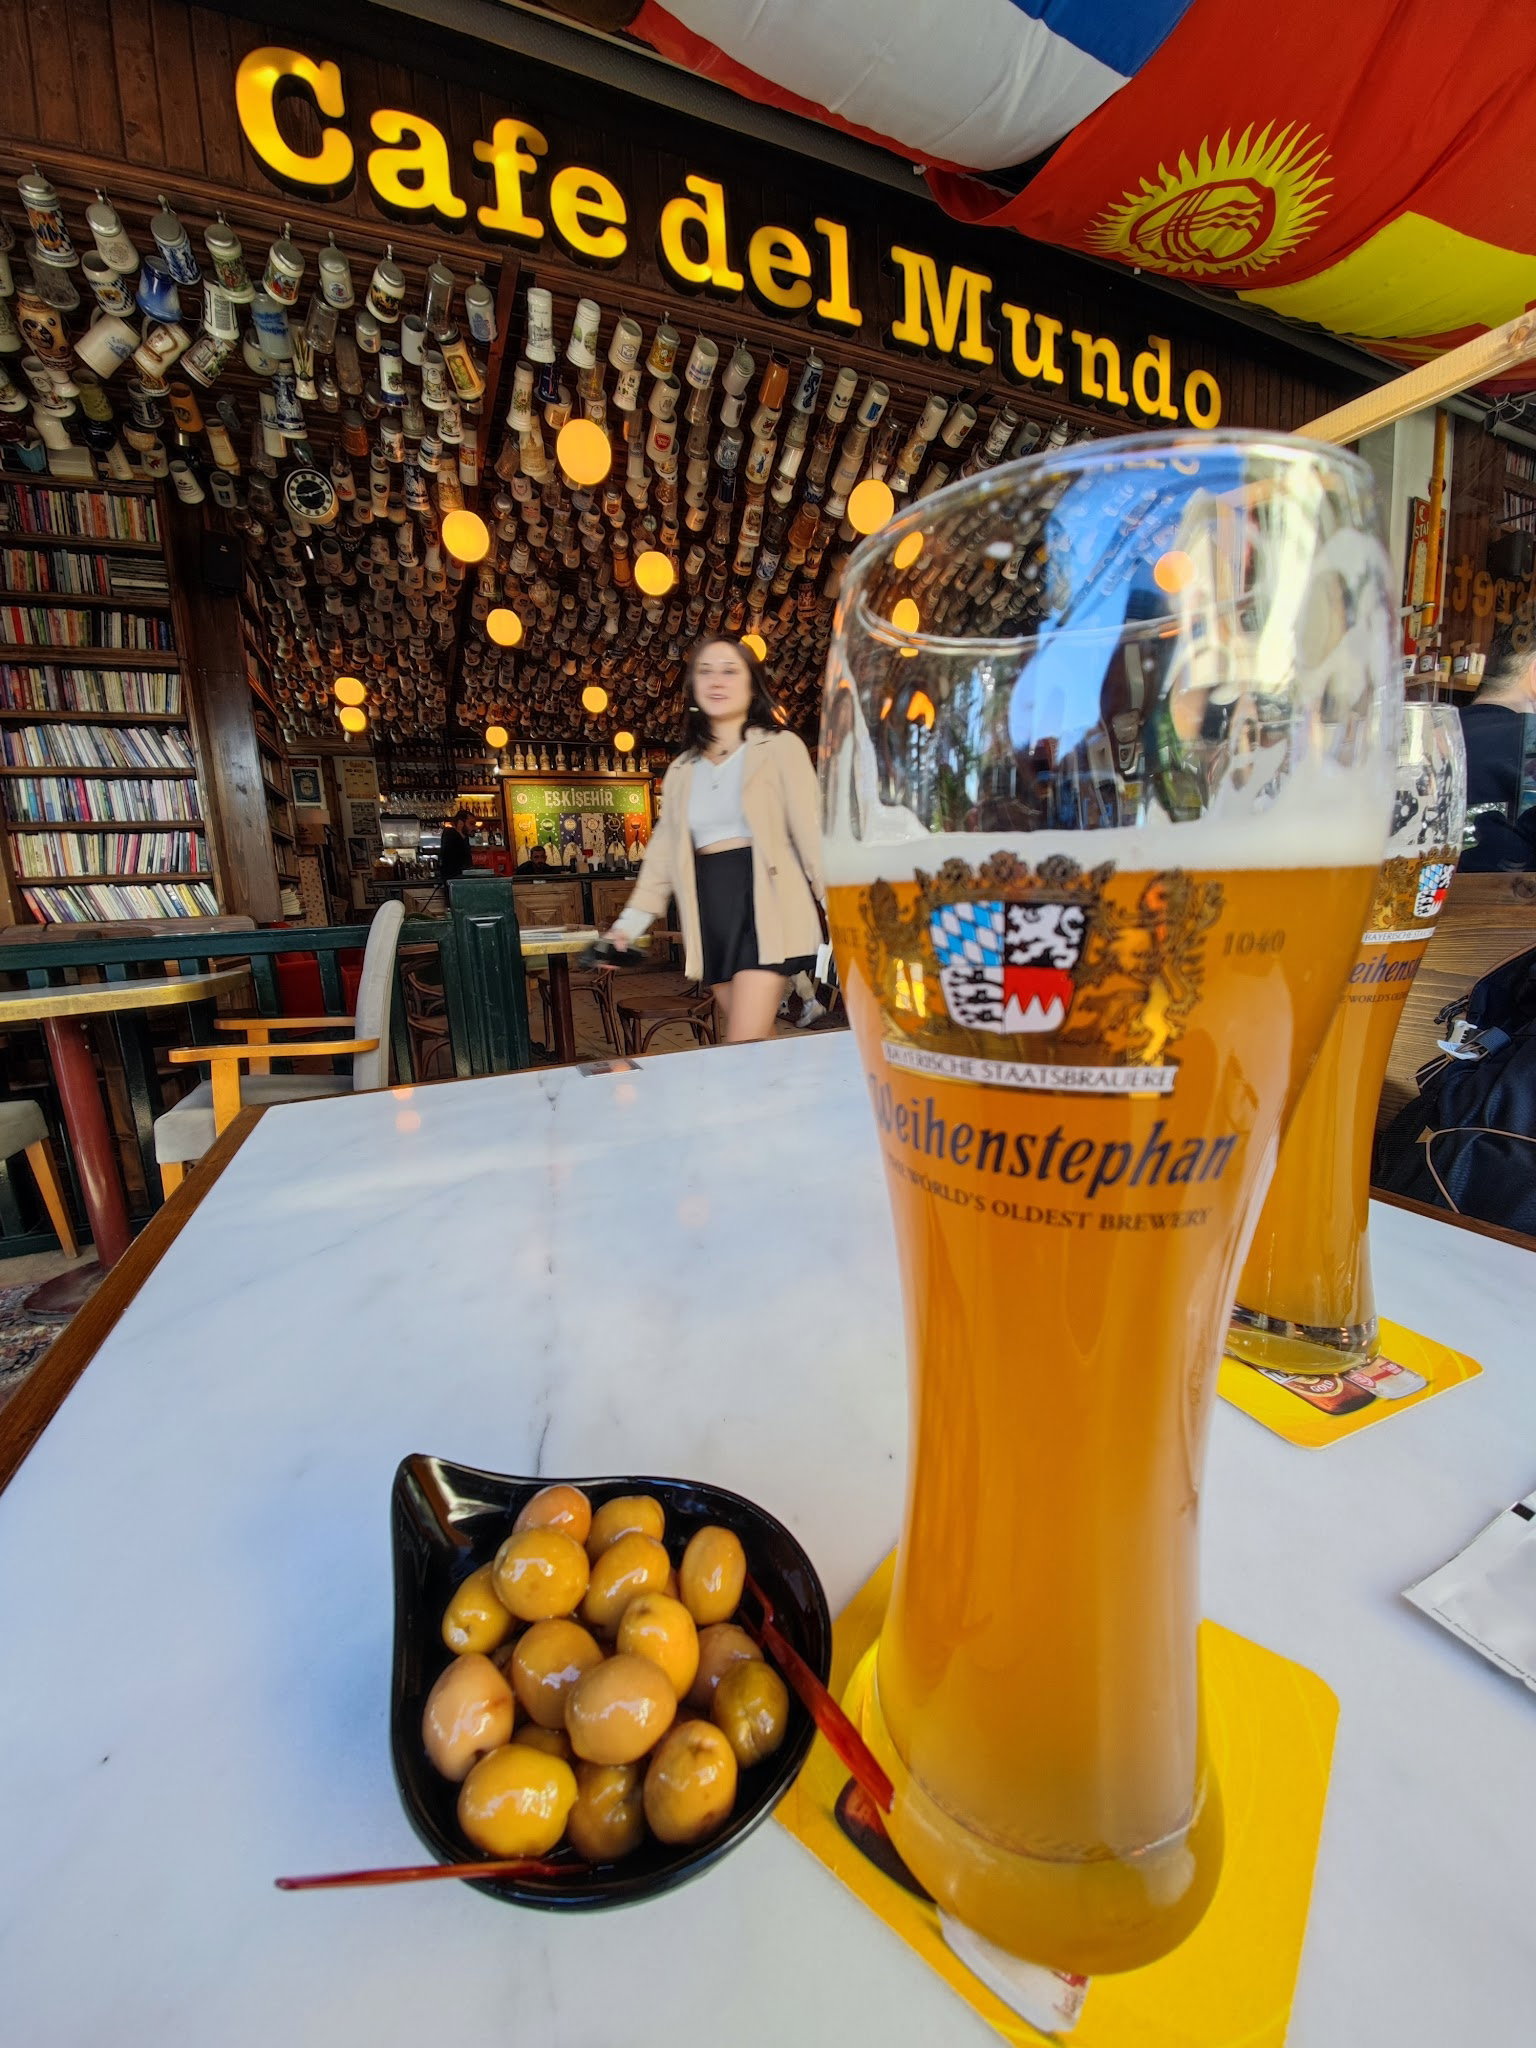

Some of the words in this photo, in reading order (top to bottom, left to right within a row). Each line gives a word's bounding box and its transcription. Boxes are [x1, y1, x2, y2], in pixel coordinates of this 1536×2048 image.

[234, 46, 628, 260] Cafe
[660, 174, 863, 327] del
[890, 245, 1223, 430] Mundo
[544, 788, 615, 808] ESKİŞEHİR
[868, 1072, 1241, 1199] Weihenstephan
[907, 1167, 986, 1212] WORLD'S
[992, 1199, 1092, 1230] OLDEST
[1099, 1207, 1214, 1231] BREWERY
[1310, 1379, 1335, 1394] GOLD
